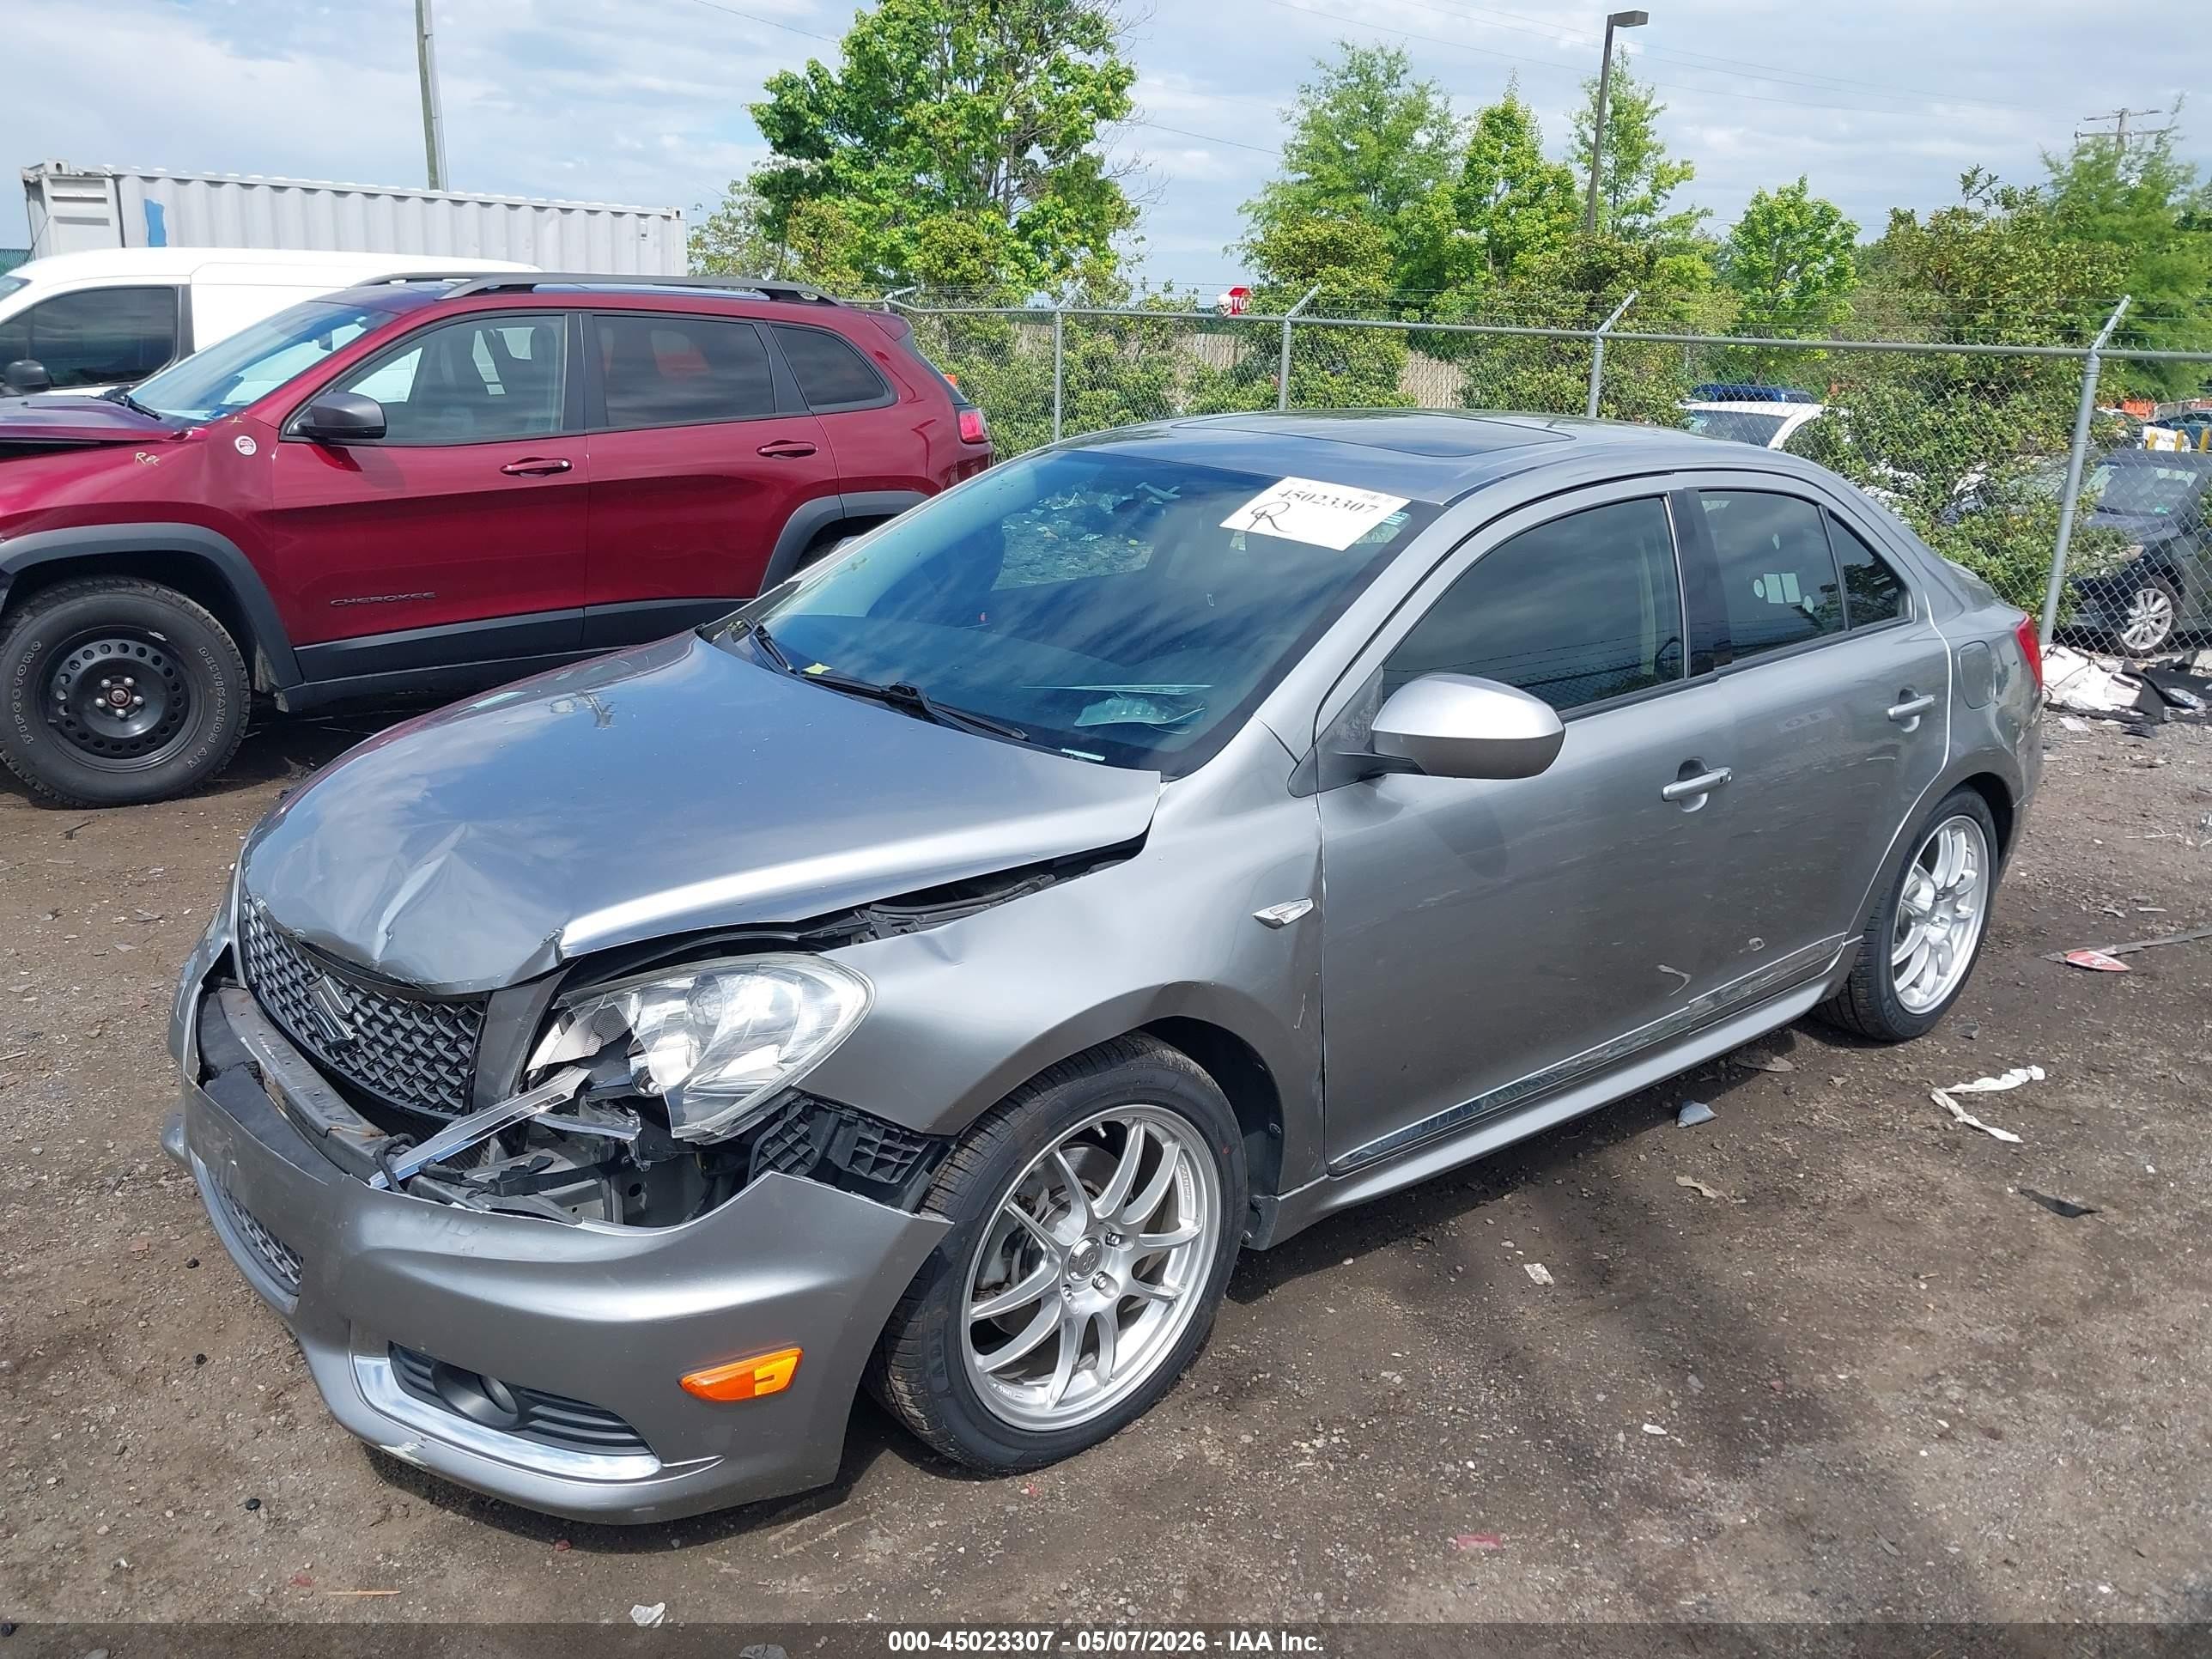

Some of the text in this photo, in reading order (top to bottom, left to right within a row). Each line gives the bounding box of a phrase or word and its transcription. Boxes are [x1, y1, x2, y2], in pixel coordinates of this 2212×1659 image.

[1277, 489, 1379, 514] 45023307
[330, 592, 436, 606] CHEROKEE
[198, 647, 227, 744] DESTINATION
